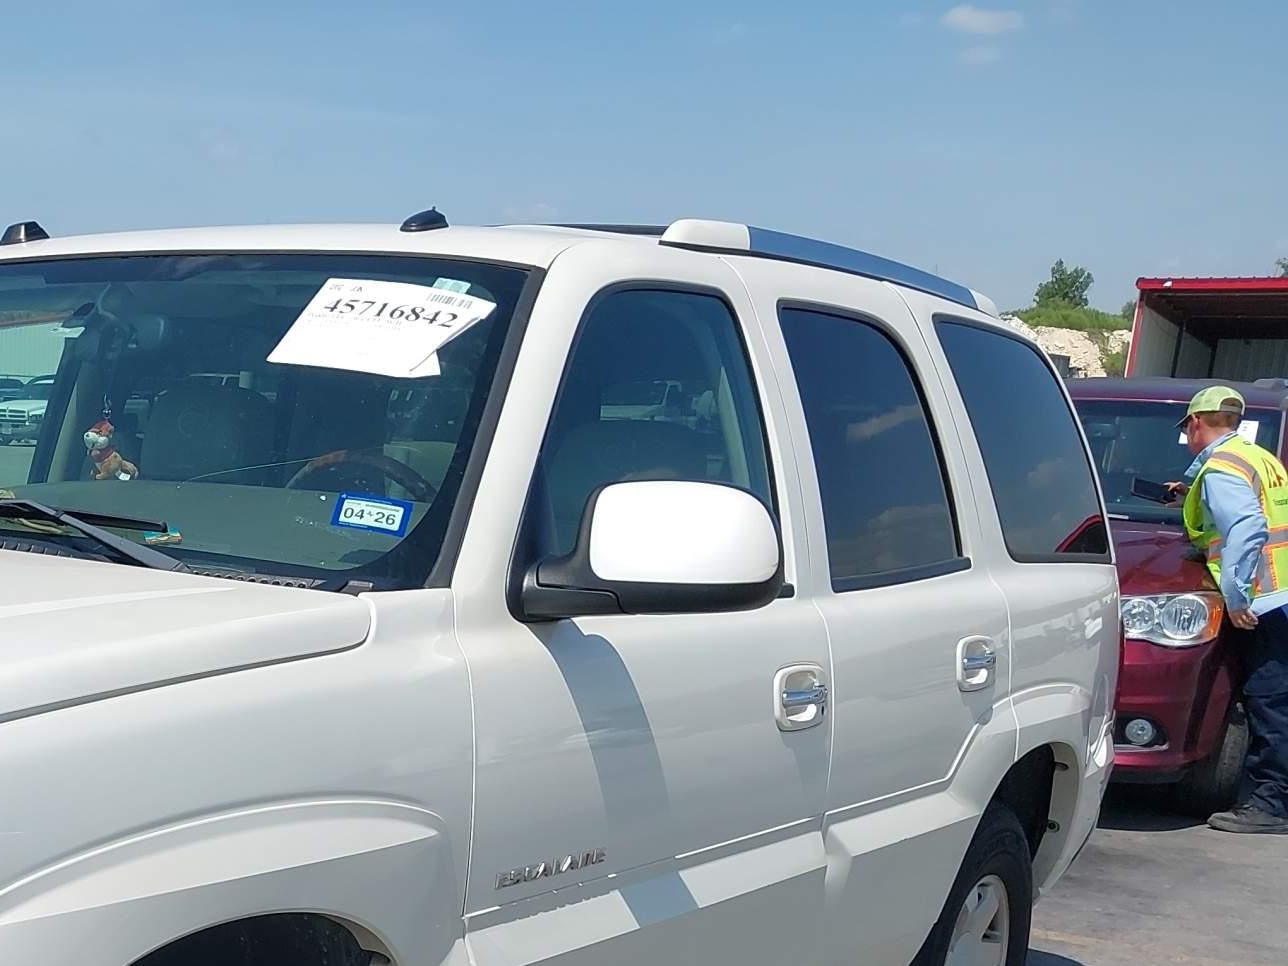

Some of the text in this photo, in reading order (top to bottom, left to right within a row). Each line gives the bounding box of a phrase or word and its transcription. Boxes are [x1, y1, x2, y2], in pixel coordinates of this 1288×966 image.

[324, 298, 459, 328] 45716842
[343, 507, 365, 520] 04
[373, 511, 397, 526] 26
